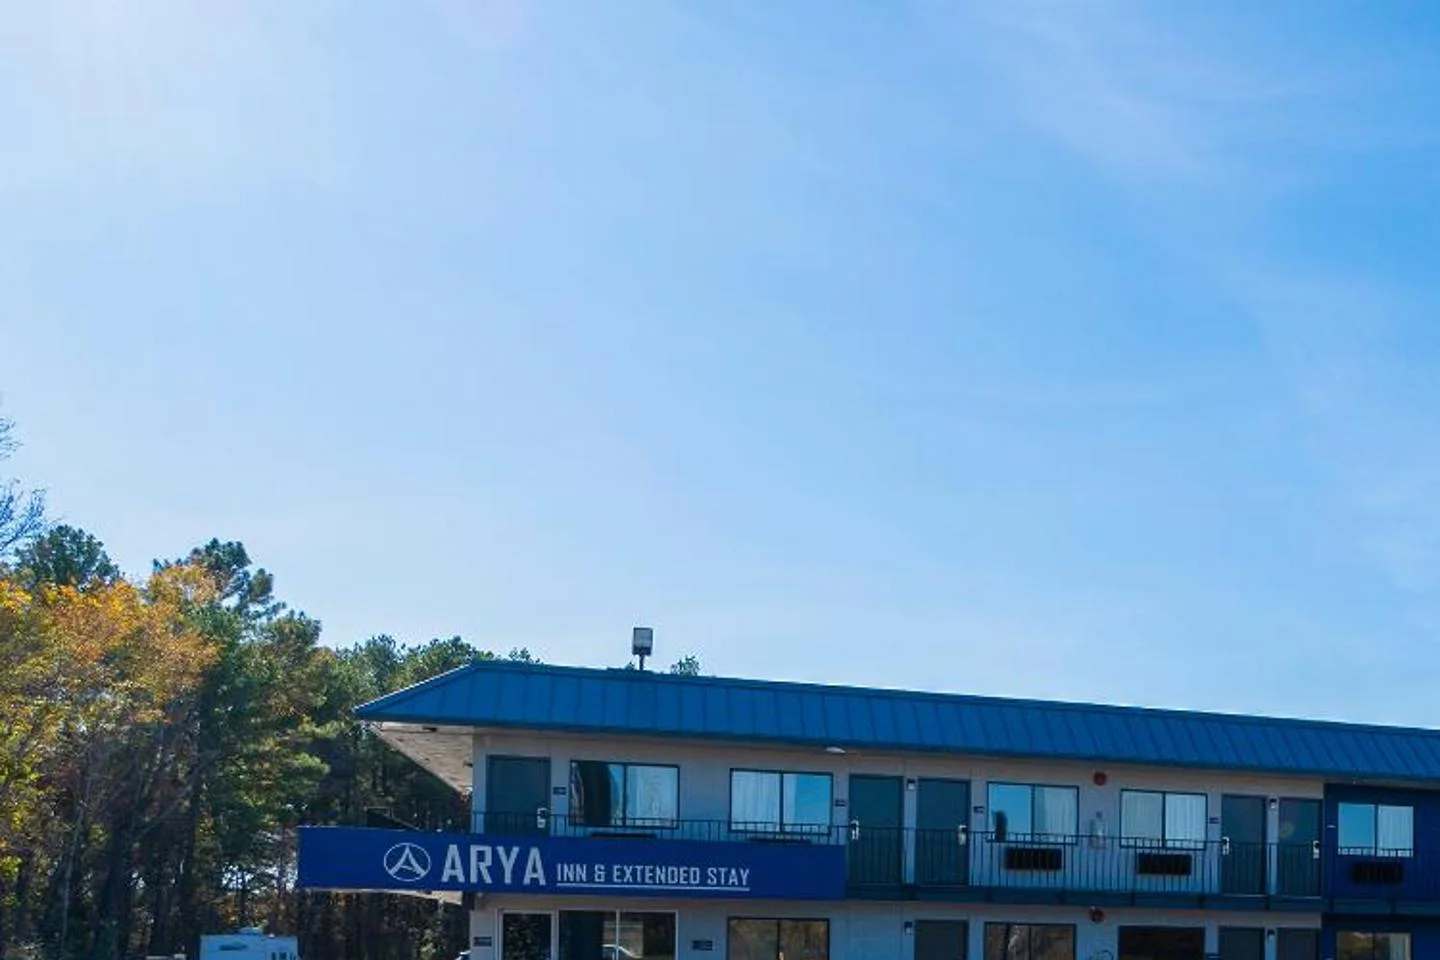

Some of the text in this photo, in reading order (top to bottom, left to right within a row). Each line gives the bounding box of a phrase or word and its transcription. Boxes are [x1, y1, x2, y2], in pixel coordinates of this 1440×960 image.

[440, 843, 751, 887] ARYA INN & EXTENDED STAY
